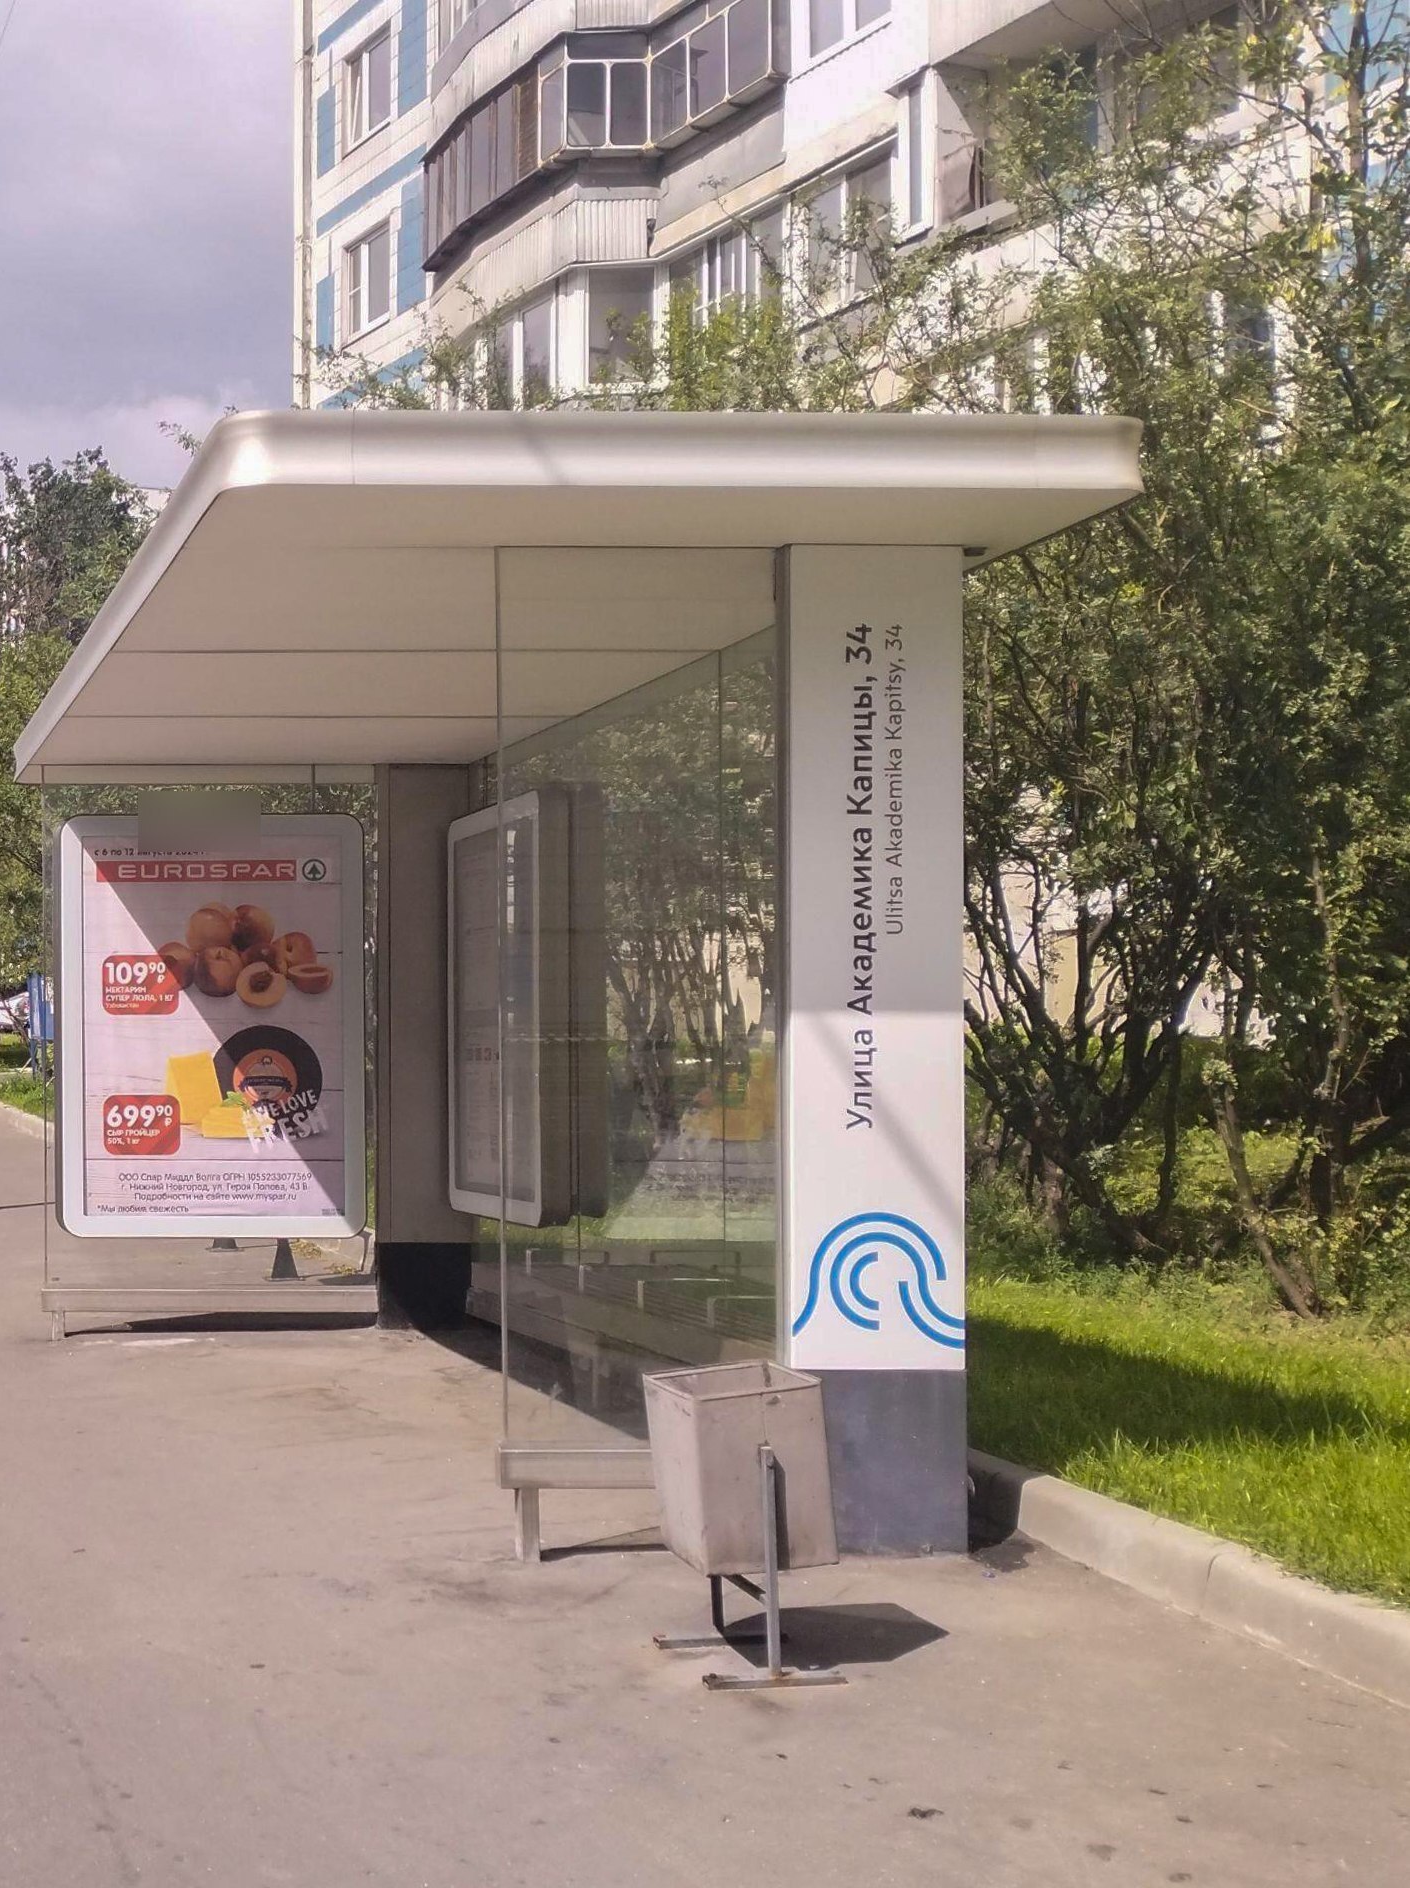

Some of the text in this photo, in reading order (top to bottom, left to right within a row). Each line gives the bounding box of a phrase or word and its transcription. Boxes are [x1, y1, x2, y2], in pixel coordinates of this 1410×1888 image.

[884, 623, 906, 935] Ulitsa Akademika Kapitsy, 34
[125, 847, 135, 857] 12
[117, 863, 295, 879] EUROSPAR
[845, 623, 878, 1130] Улица Академика Капицы, 34
[105, 985, 147, 994] НЕКТАРИН
[105, 994, 131, 1002] СУПЕР
[280, 1088, 318, 1114] LOVE
[106, 1129, 124, 1137] СЫР
[118, 1172, 139, 1182] ООО
[140, 1173, 163, 1183] Спар
[196, 1172, 221, 1182] Волга
[223, 1172, 246, 1182] ОГРН
[247, 1172, 312, 1182] 1055233077569
[129, 1183, 164, 1191] Нижний
[226, 1182, 251, 1192] Героя
[289, 1182, 300, 1191] 43
[134, 1192, 297, 1203] Подробности на сайте www.myspar.ru
[148, 1205, 190, 1213] свежесть
